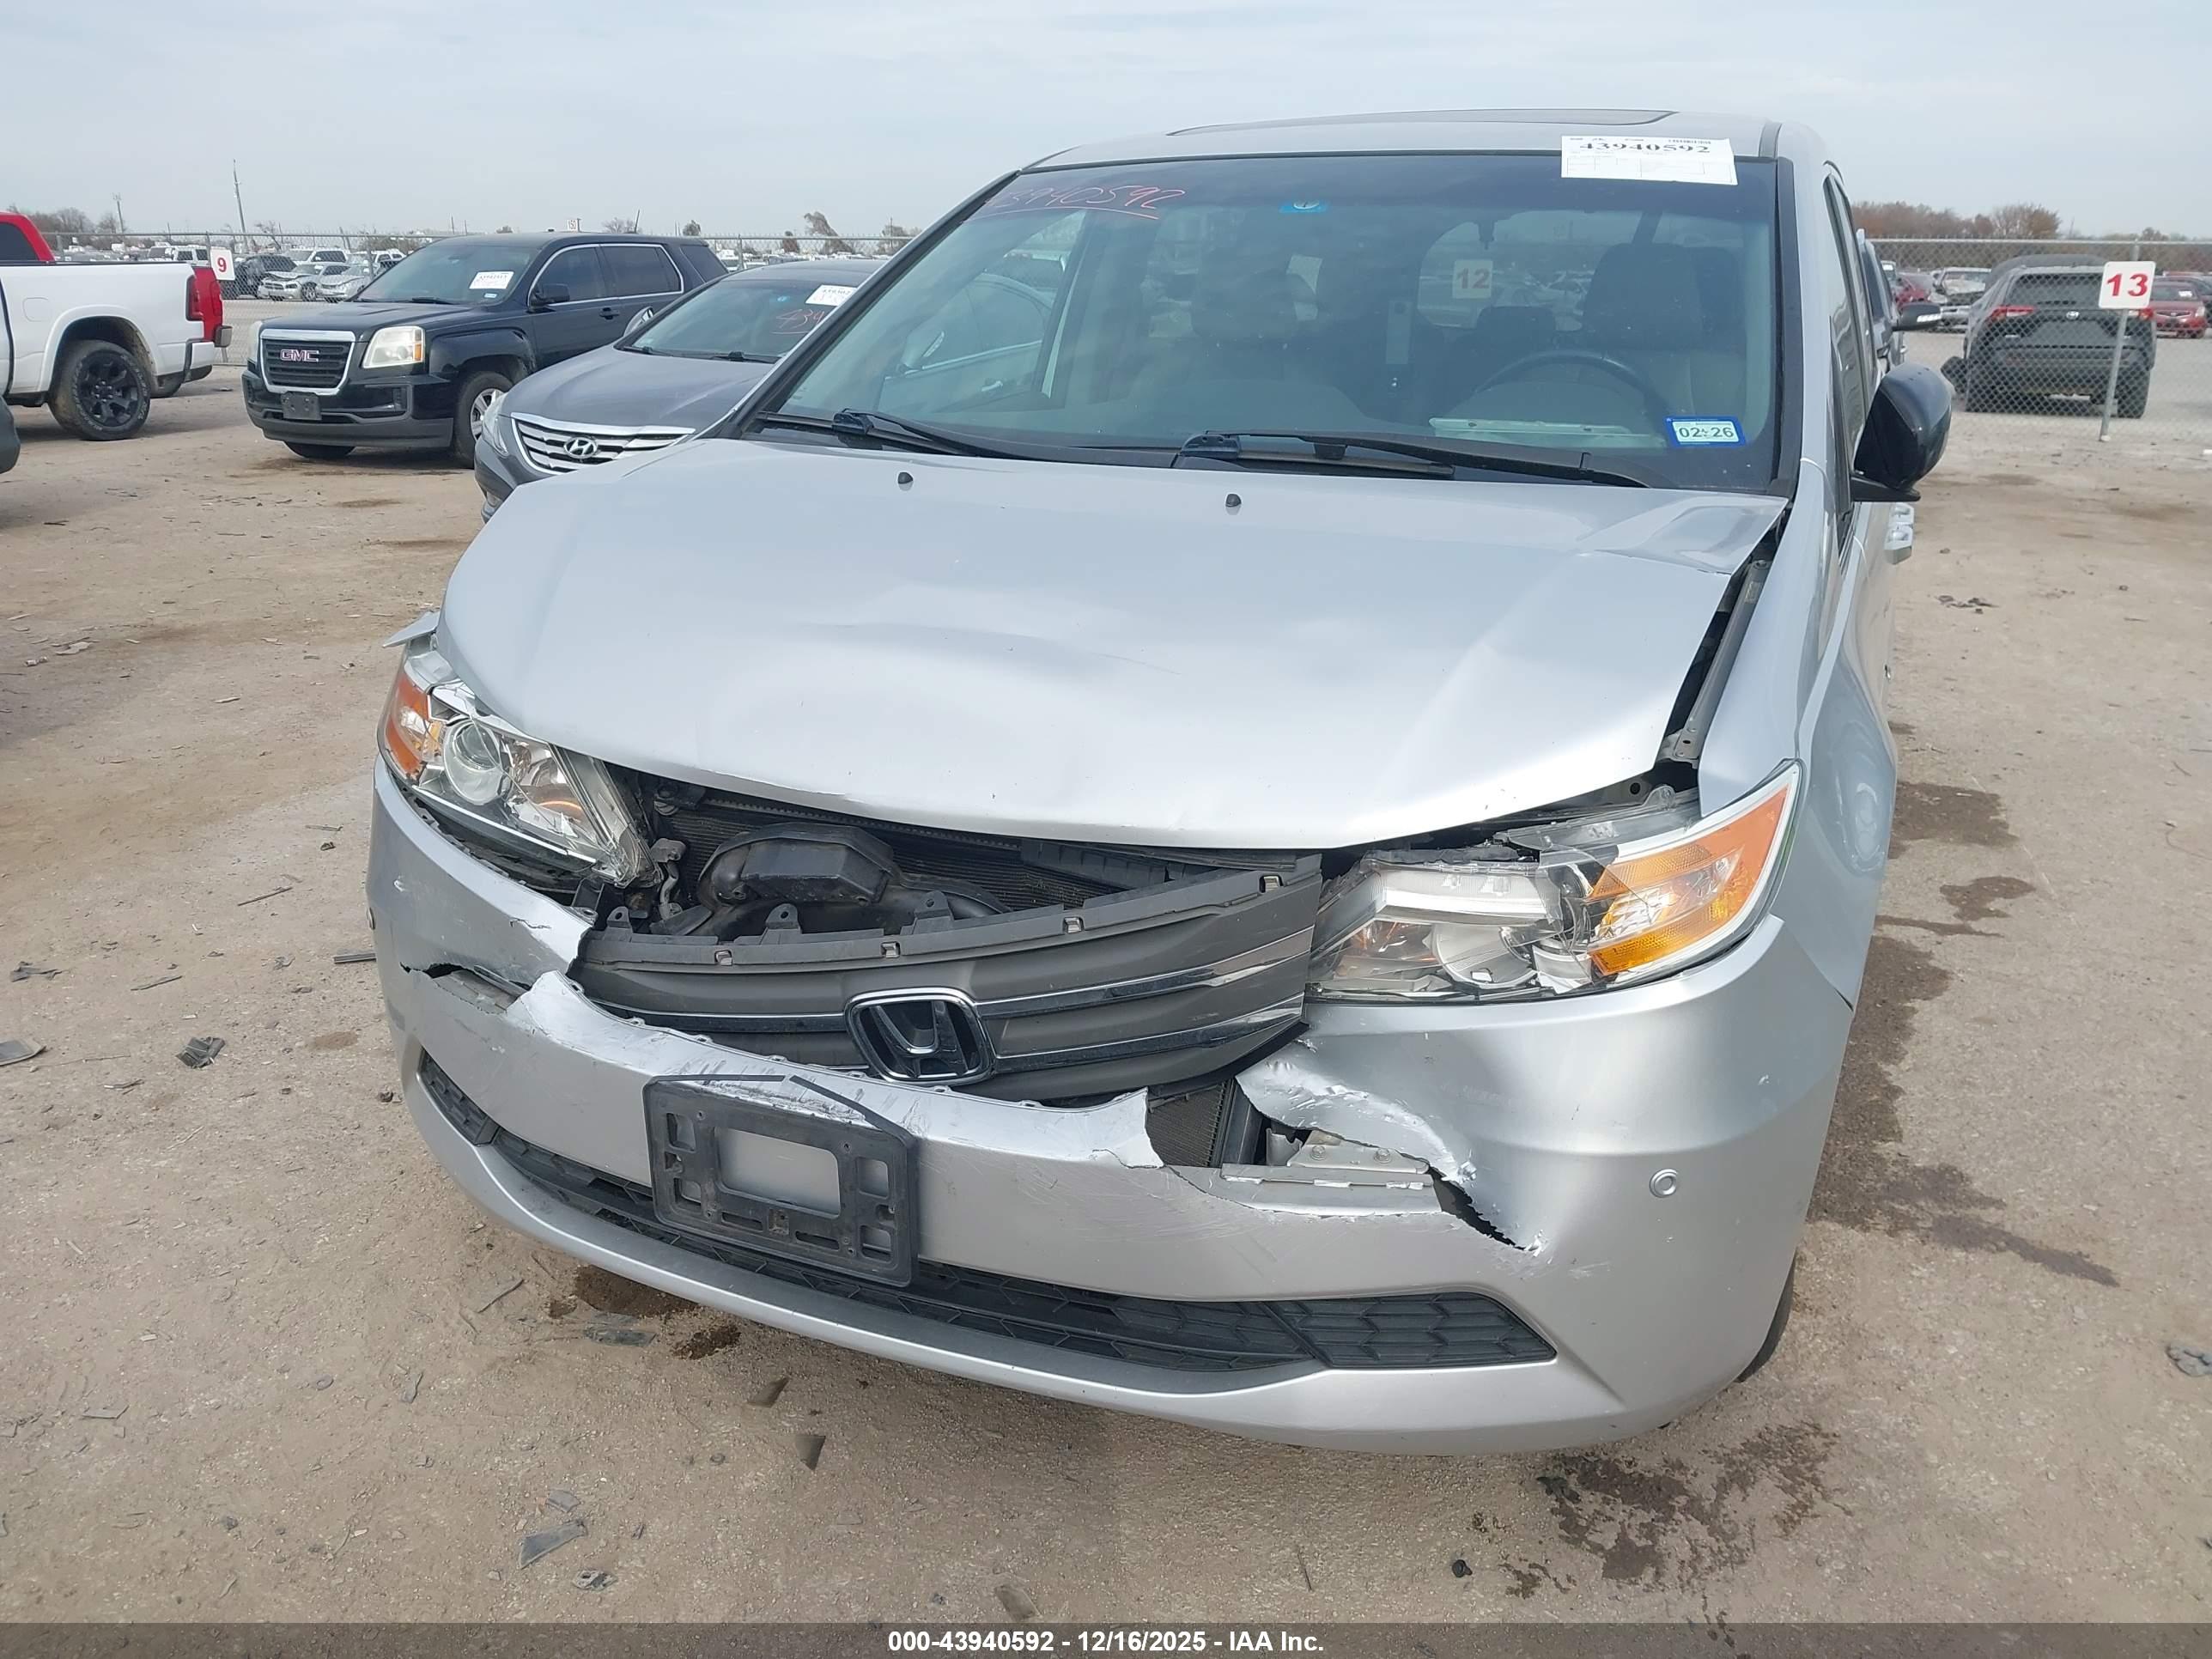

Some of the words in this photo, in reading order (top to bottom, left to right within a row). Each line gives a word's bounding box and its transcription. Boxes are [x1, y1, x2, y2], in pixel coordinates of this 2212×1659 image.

[1580, 142, 1711, 154] 43940592
[217, 257, 227, 273] 9
[1456, 267, 1490, 289] 12
[2106, 272, 2148, 297] 13
[280, 349, 319, 362] GMC
[1679, 427, 1703, 438] 02
[1710, 427, 1734, 438] 26
